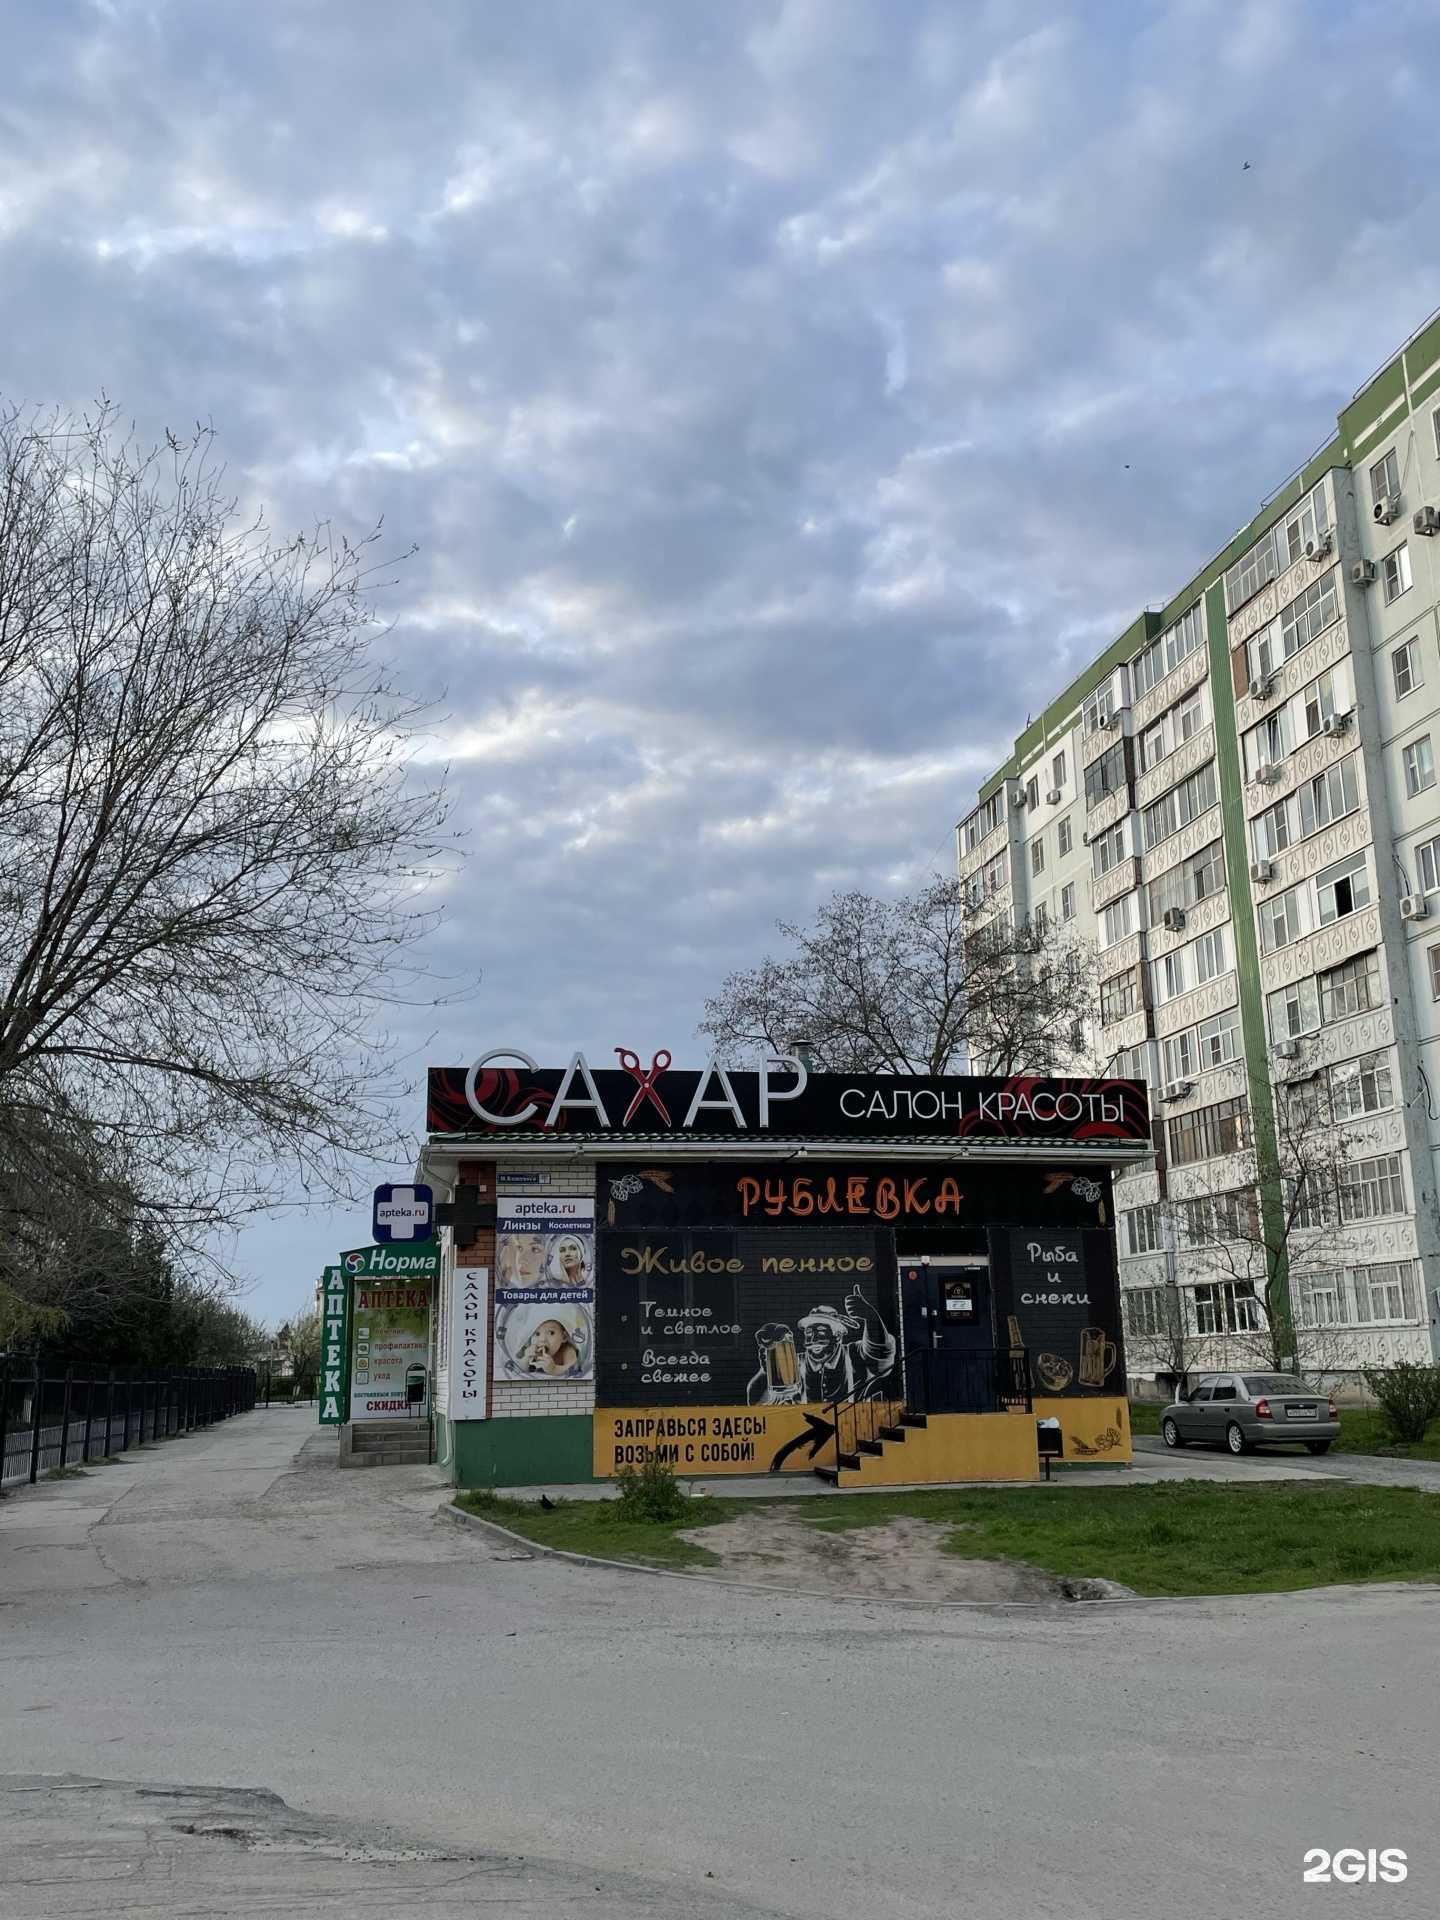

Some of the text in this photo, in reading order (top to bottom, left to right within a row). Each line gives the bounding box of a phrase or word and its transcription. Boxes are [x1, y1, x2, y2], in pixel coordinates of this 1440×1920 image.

[465, 1048, 807, 1128] САХАР
[840, 1089, 1124, 1122] САЛОН КРАСОТЫ
[379, 1207, 425, 1219] apteka.ru
[515, 1201, 576, 1216] apteka.ru
[502, 1220, 541, 1231] Линзы
[548, 1221, 591, 1230] Косметика
[369, 1250, 436, 1272] Норма
[621, 1246, 874, 1275] Живое пенное
[1026, 1242, 1079, 1263] Рыба
[1047, 1271, 1062, 1283] и
[358, 1290, 428, 1309] АПТЕКА
[502, 1290, 588, 1301] Товары для детей
[1020, 1293, 1092, 1304] снеки
[639, 1301, 713, 1318] Темное
[462, 1272, 479, 1399] САЛОН КРАСОТЫ
[640, 1322, 743, 1335] и светлое
[322, 1269, 345, 1419] АПТЕКА
[641, 1349, 710, 1368] Всегда
[640, 1371, 712, 1384] свежее
[614, 1416, 767, 1438] ЗАПРАВЬСЯ ЗДЕСЬ!
[614, 1437, 755, 1464] ВОЗЬМИ С СОБОЙ!
